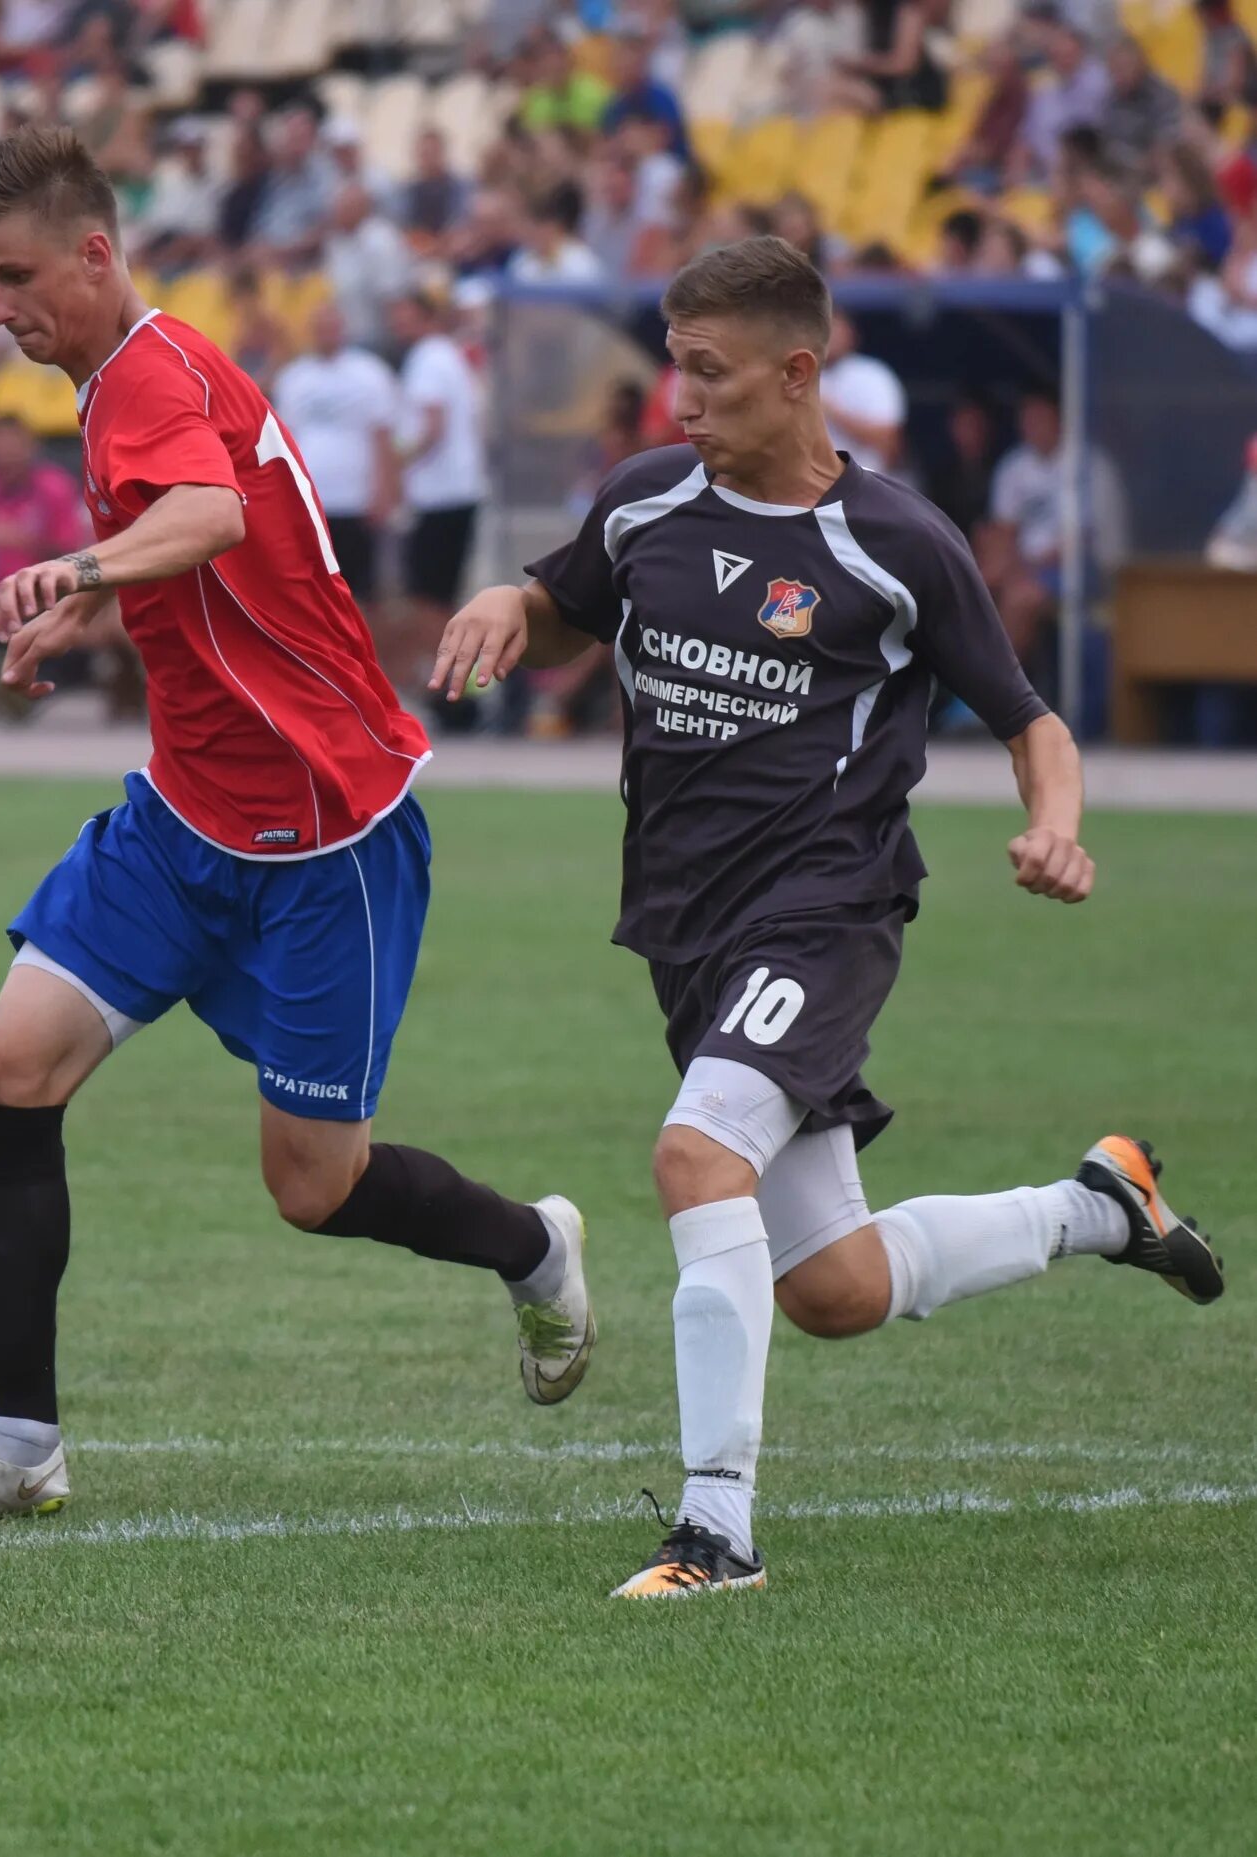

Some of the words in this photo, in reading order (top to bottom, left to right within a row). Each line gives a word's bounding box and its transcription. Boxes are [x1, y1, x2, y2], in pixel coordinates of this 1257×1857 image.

[639, 623, 814, 696] СНОВНОЙ
[635, 671, 799, 725] КОММЕРЧЕСКИЙ
[656, 706, 739, 741] ЦЕНТР
[263, 830, 296, 838] PATRICK
[720, 966, 805, 1045] 10
[275, 1073, 349, 1100] PATRICK
